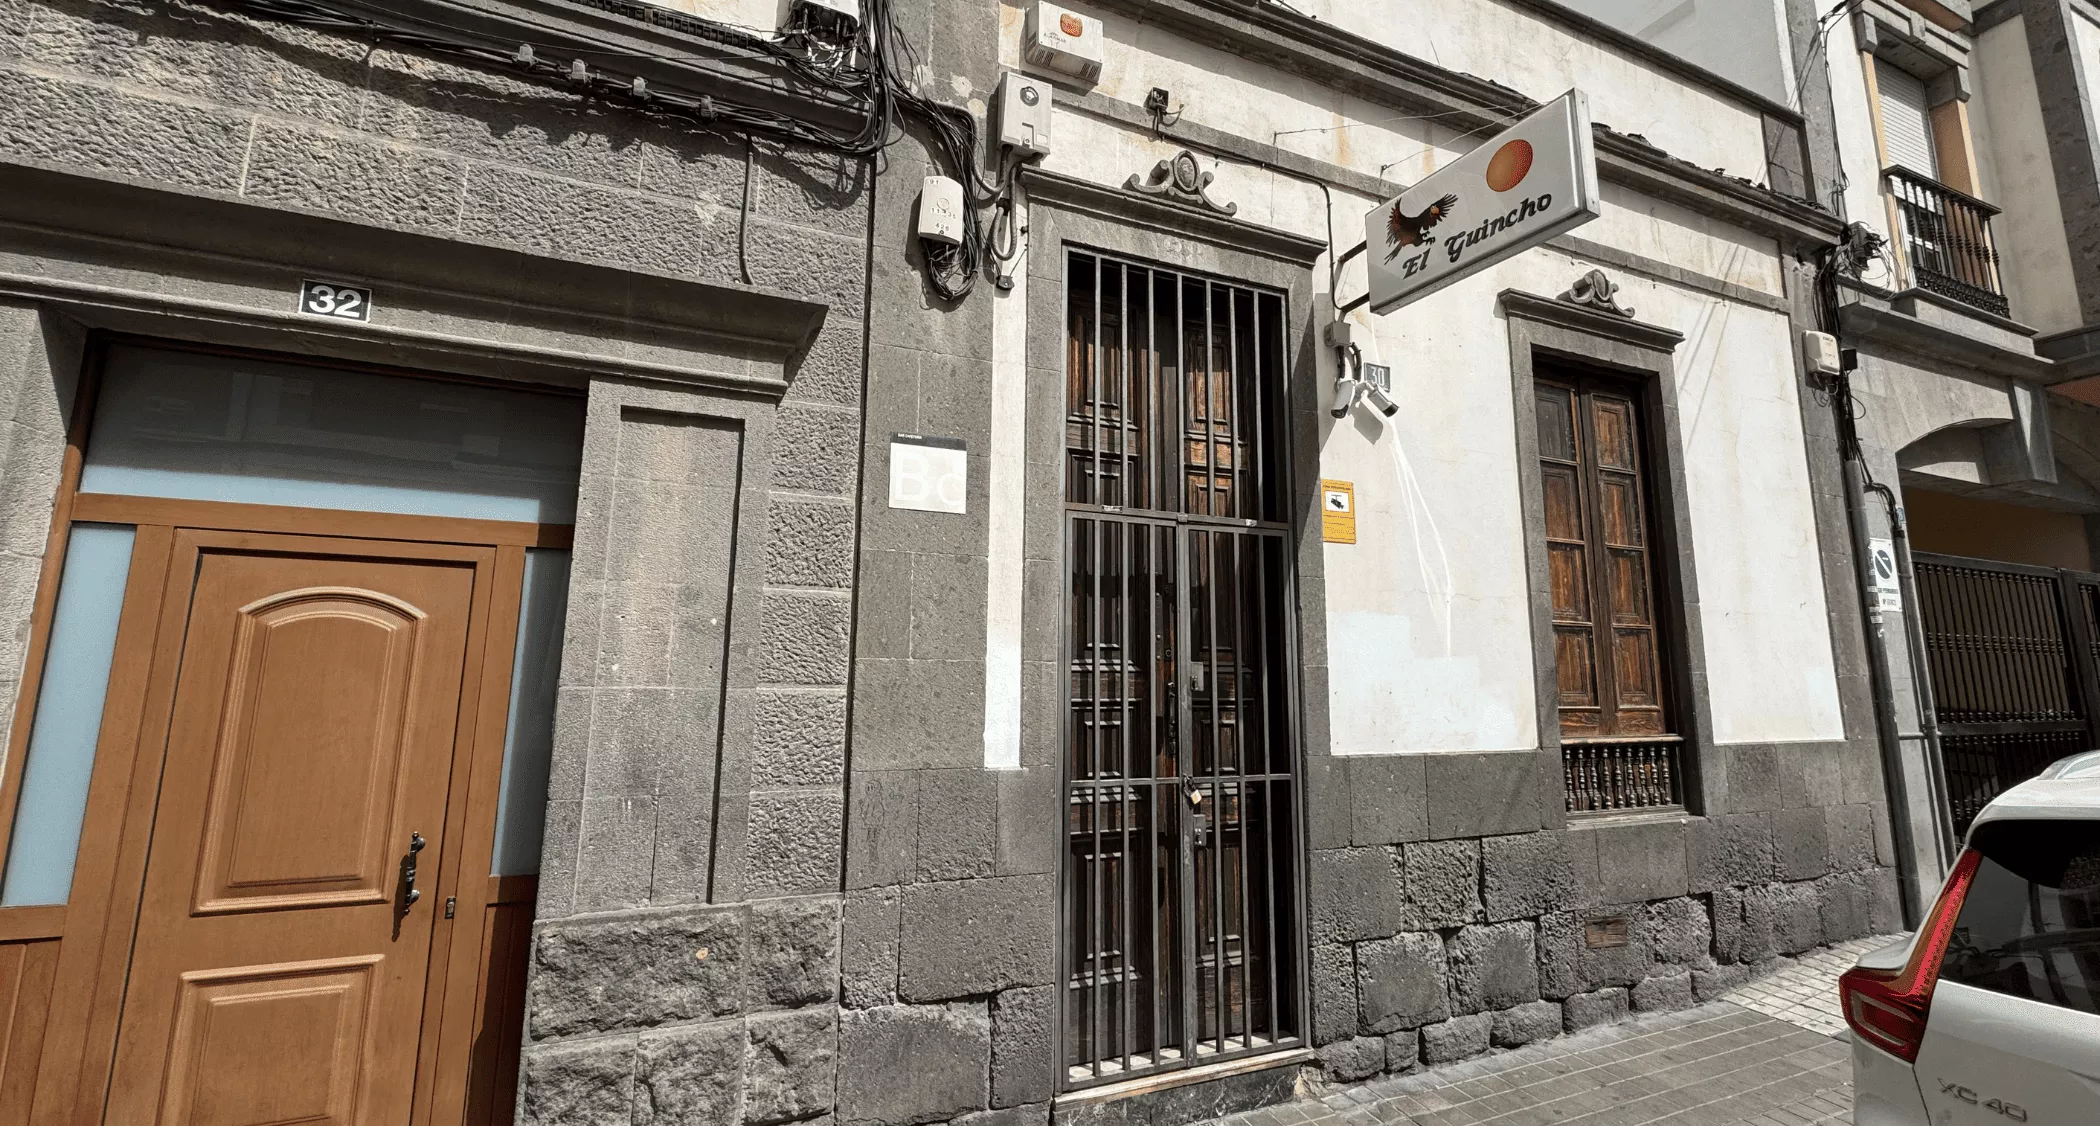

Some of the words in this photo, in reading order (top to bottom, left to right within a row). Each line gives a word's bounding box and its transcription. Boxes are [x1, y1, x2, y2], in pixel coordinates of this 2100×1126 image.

[1402, 247, 1431, 280] El
[1444, 193, 1552, 263] Guincho
[308, 284, 362, 318] 32
[1370, 365, 1385, 386] 30
